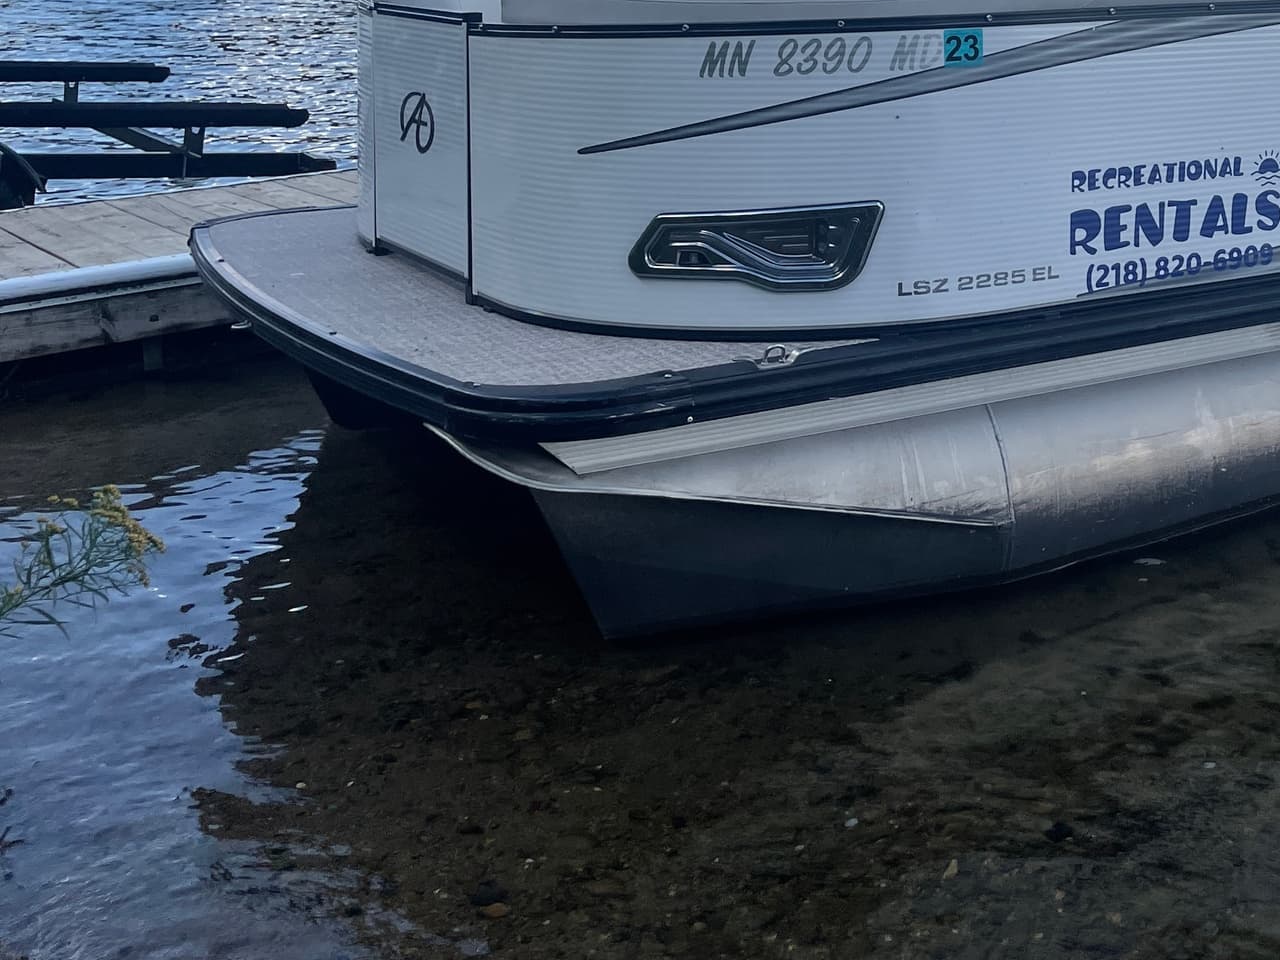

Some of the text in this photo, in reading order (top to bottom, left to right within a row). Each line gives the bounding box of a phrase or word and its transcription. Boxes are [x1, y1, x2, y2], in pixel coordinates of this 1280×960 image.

[699, 39, 756, 78] MN
[773, 36, 873, 77] 8390
[945, 34, 980, 62] 23
[1071, 156, 1244, 193] RECREATIONAL
[897, 265, 1060, 297] LSZ 2285 EL
[1086, 243, 1274, 294] (218) 820-6909
